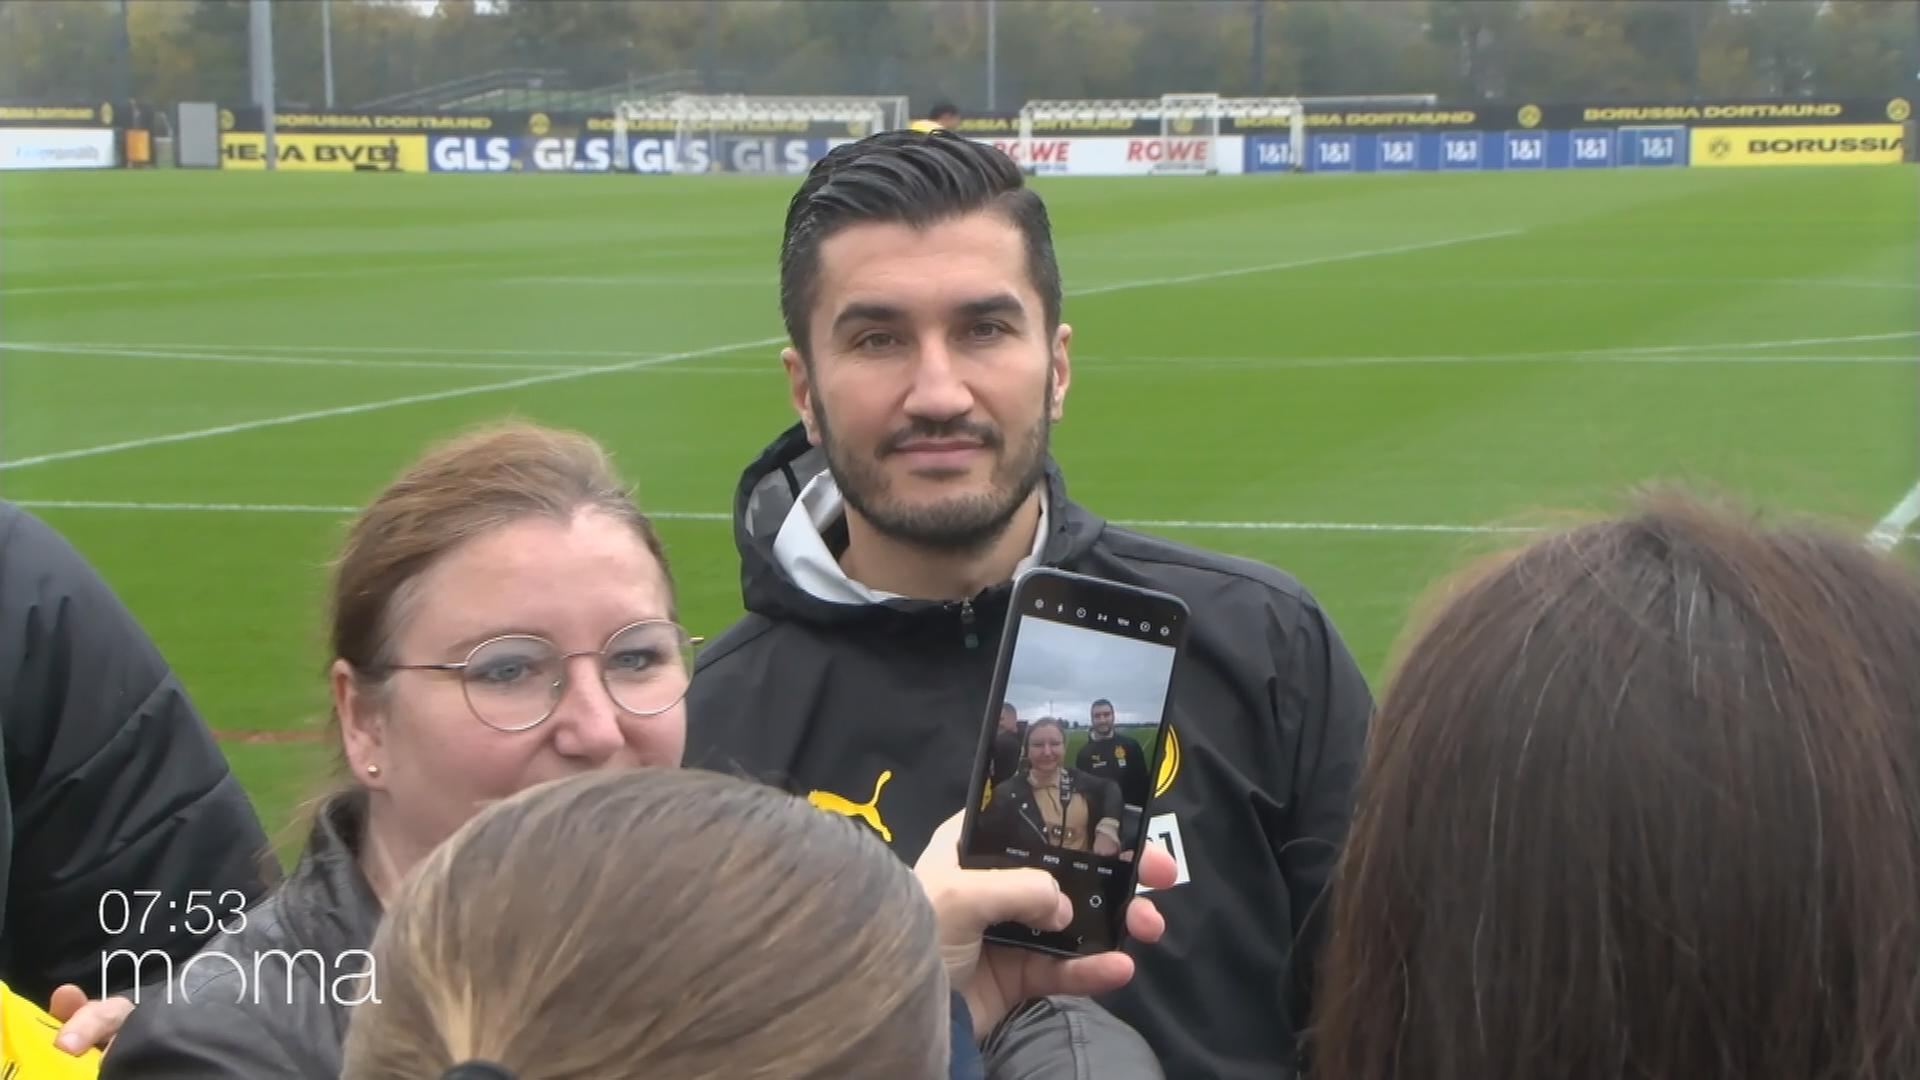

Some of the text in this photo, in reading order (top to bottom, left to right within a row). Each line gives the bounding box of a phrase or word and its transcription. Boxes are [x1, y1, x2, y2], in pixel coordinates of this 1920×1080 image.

[1346, 111, 1476, 126] DORTMUND
[1583, 104, 1842, 122] BORUSSIA DORTMUND
[433, 136, 511, 171] GLS
[533, 137, 611, 171] GLS
[632, 138, 710, 172] GLS
[732, 138, 809, 173] GLS
[1126, 140, 1209, 162] ROWE
[1318, 141, 1351, 164] 1&1
[1381, 140, 1414, 163] 1&1
[1445, 140, 1478, 162] 1&1
[1509, 138, 1542, 161] 1&1
[1574, 137, 1607, 160] 1&1
[1640, 136, 1674, 159] 1&1
